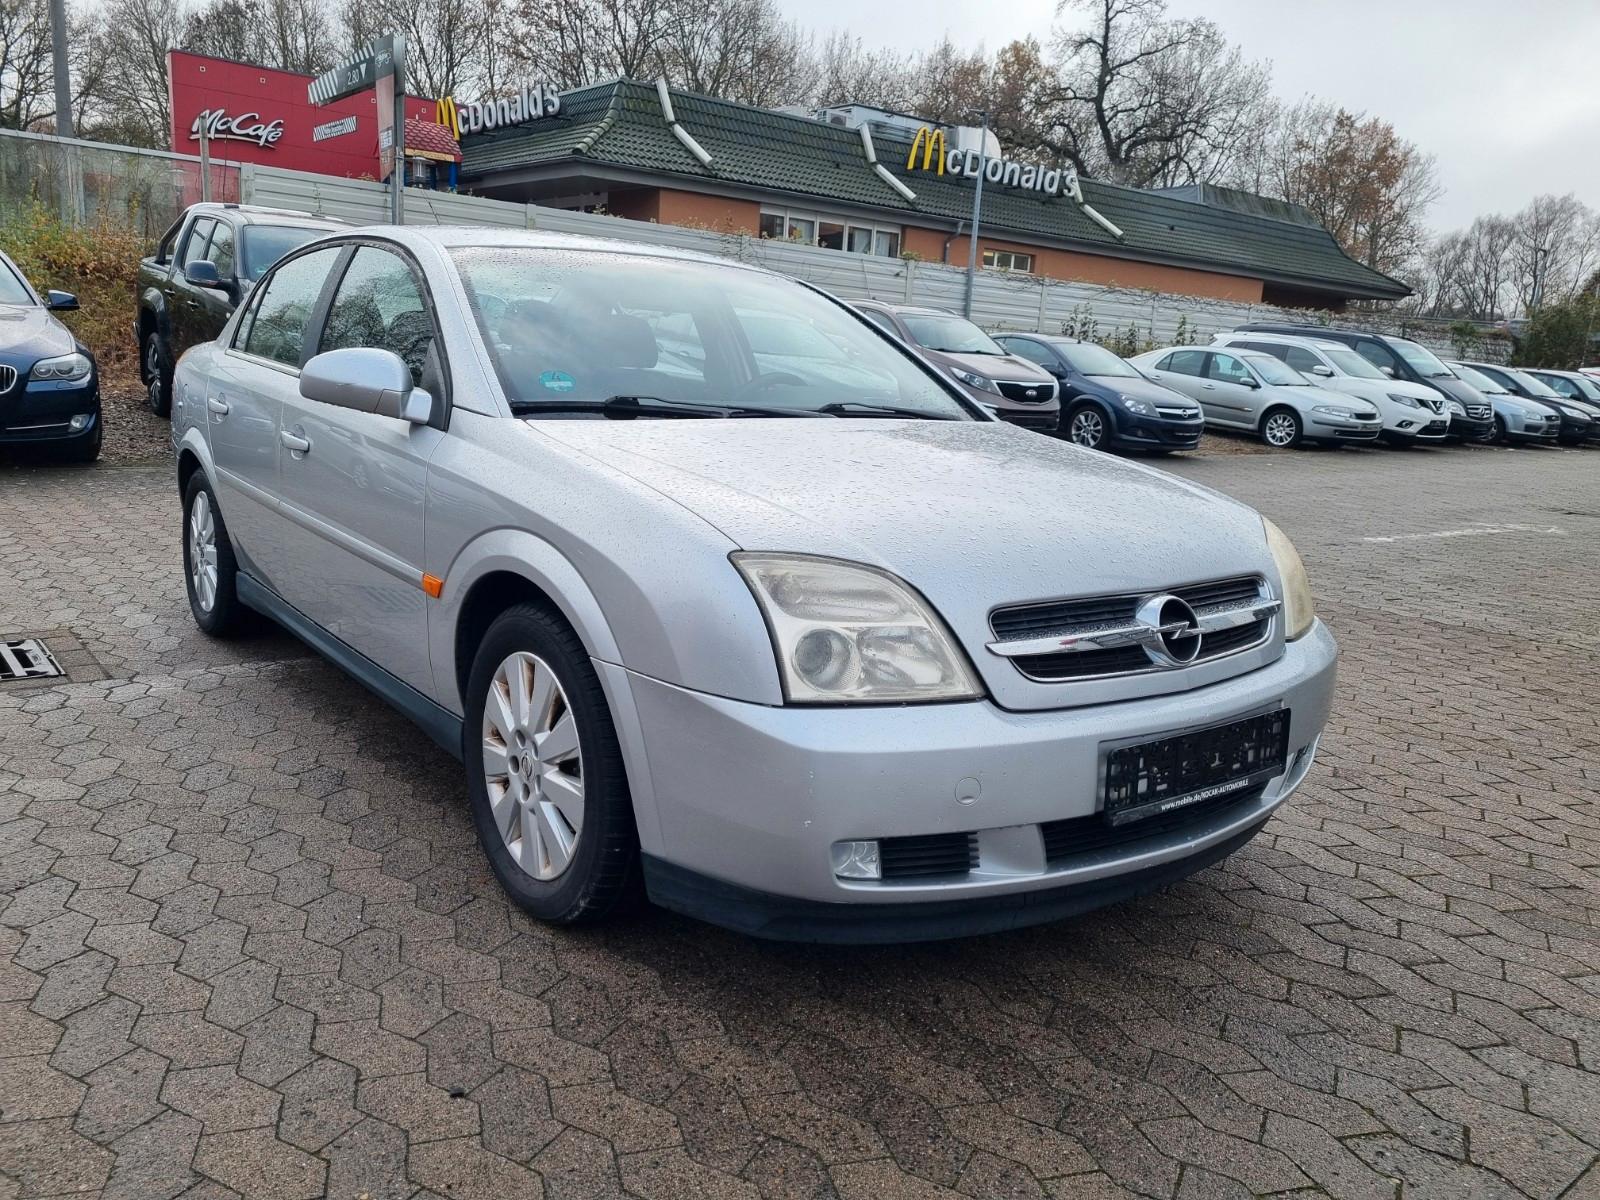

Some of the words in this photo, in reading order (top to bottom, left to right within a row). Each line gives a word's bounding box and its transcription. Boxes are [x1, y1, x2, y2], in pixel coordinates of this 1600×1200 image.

[191, 109, 284, 146] McCafé
[436, 82, 560, 140] McDonald's
[907, 126, 1076, 197] McDonald's
